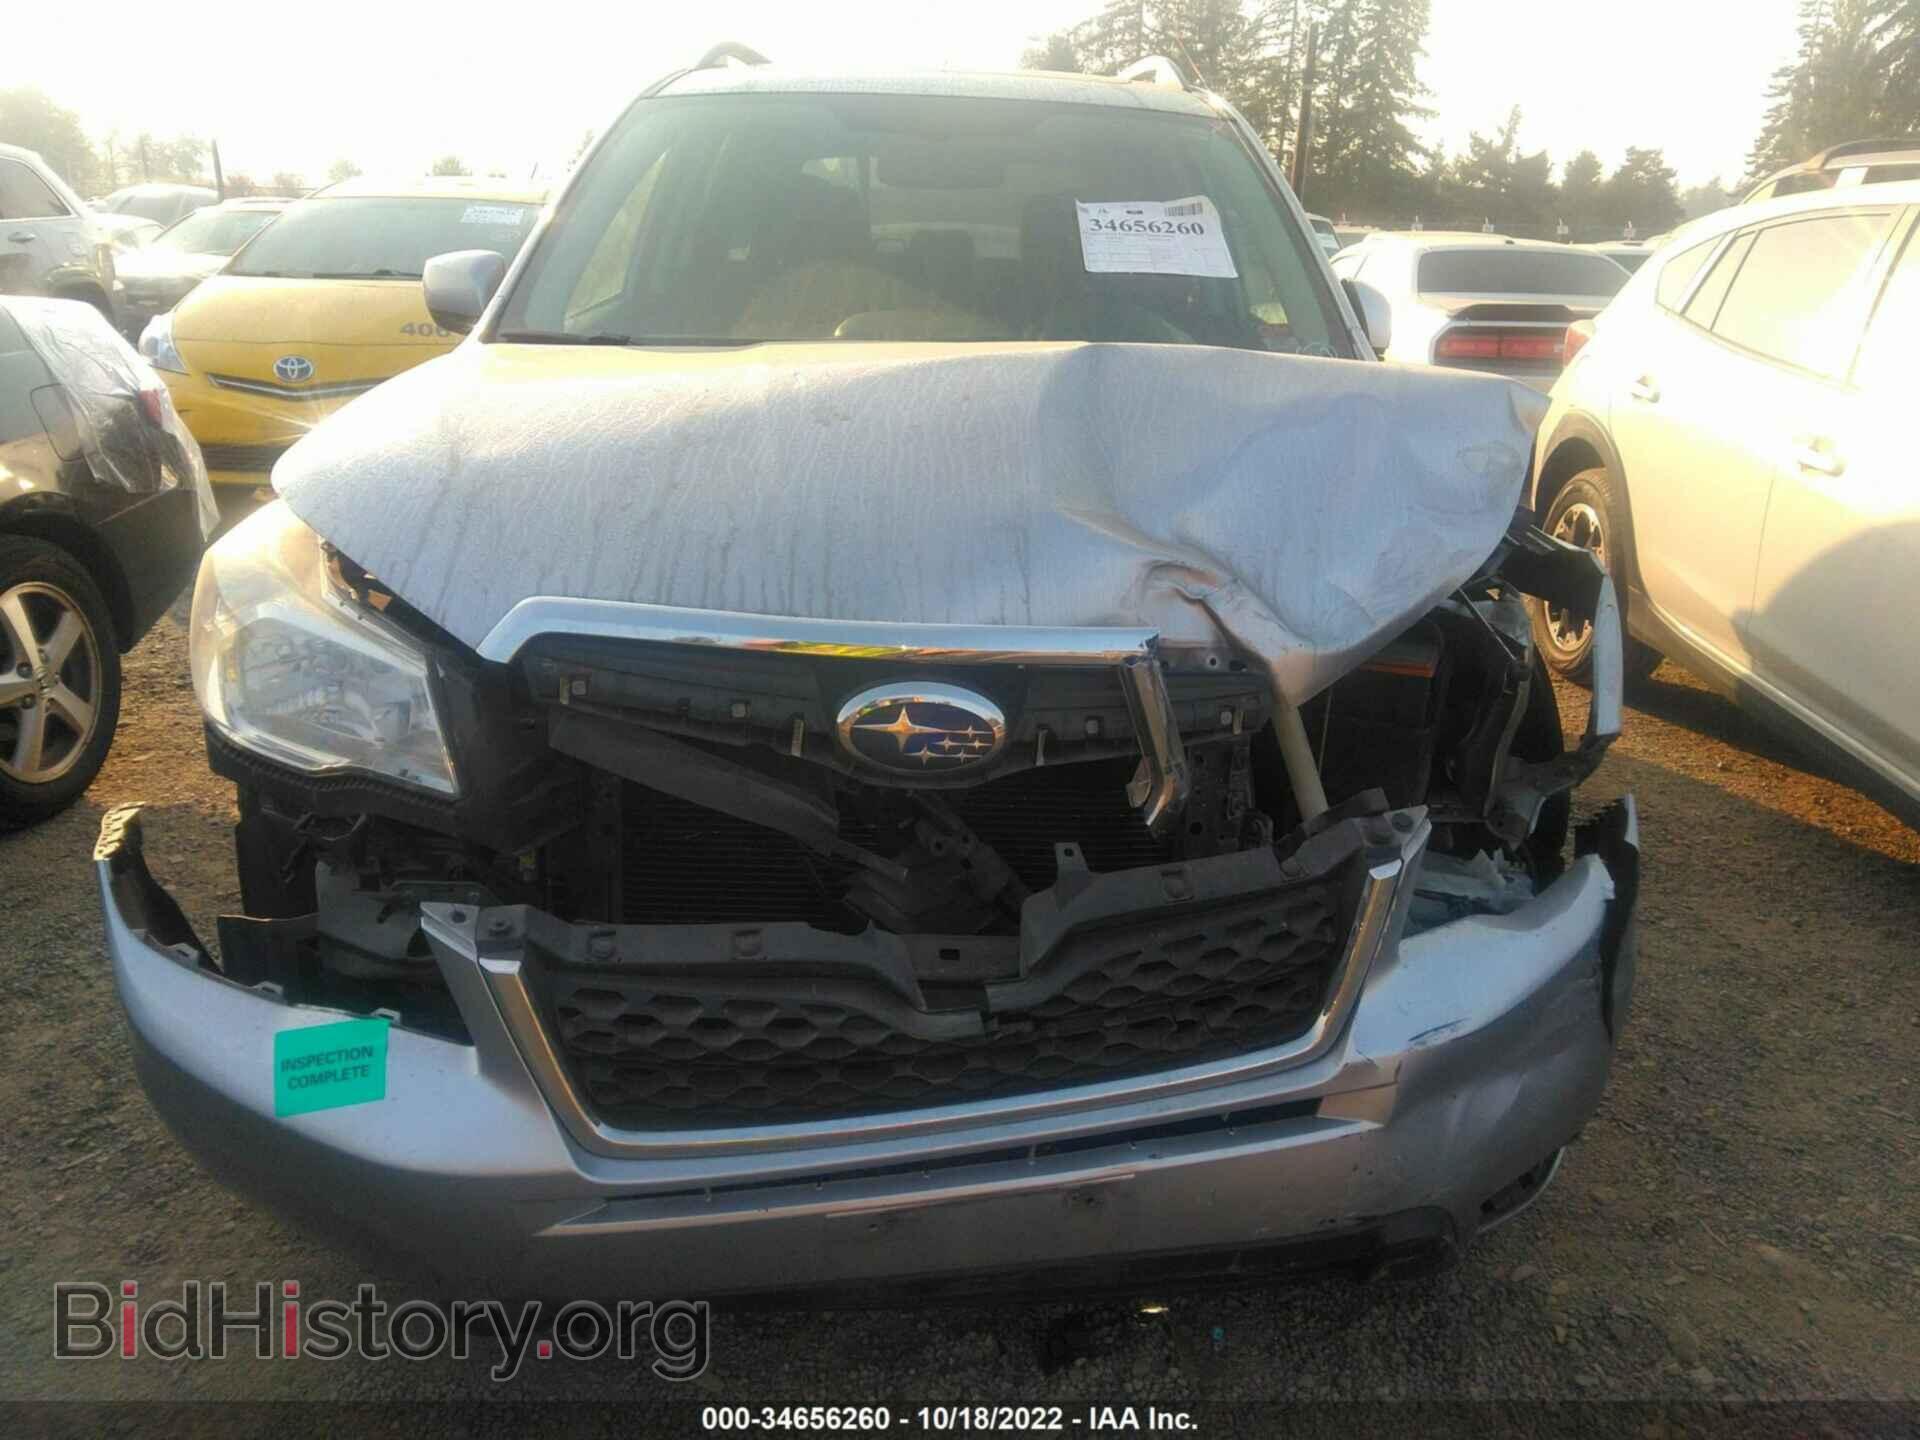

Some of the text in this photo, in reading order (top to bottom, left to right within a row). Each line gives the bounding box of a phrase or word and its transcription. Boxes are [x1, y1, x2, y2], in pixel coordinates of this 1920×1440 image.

[1089, 219, 1204, 235] 34656260
[281, 1046, 373, 1072] INSPECTION
[288, 1065, 369, 1090] COMPLETE
